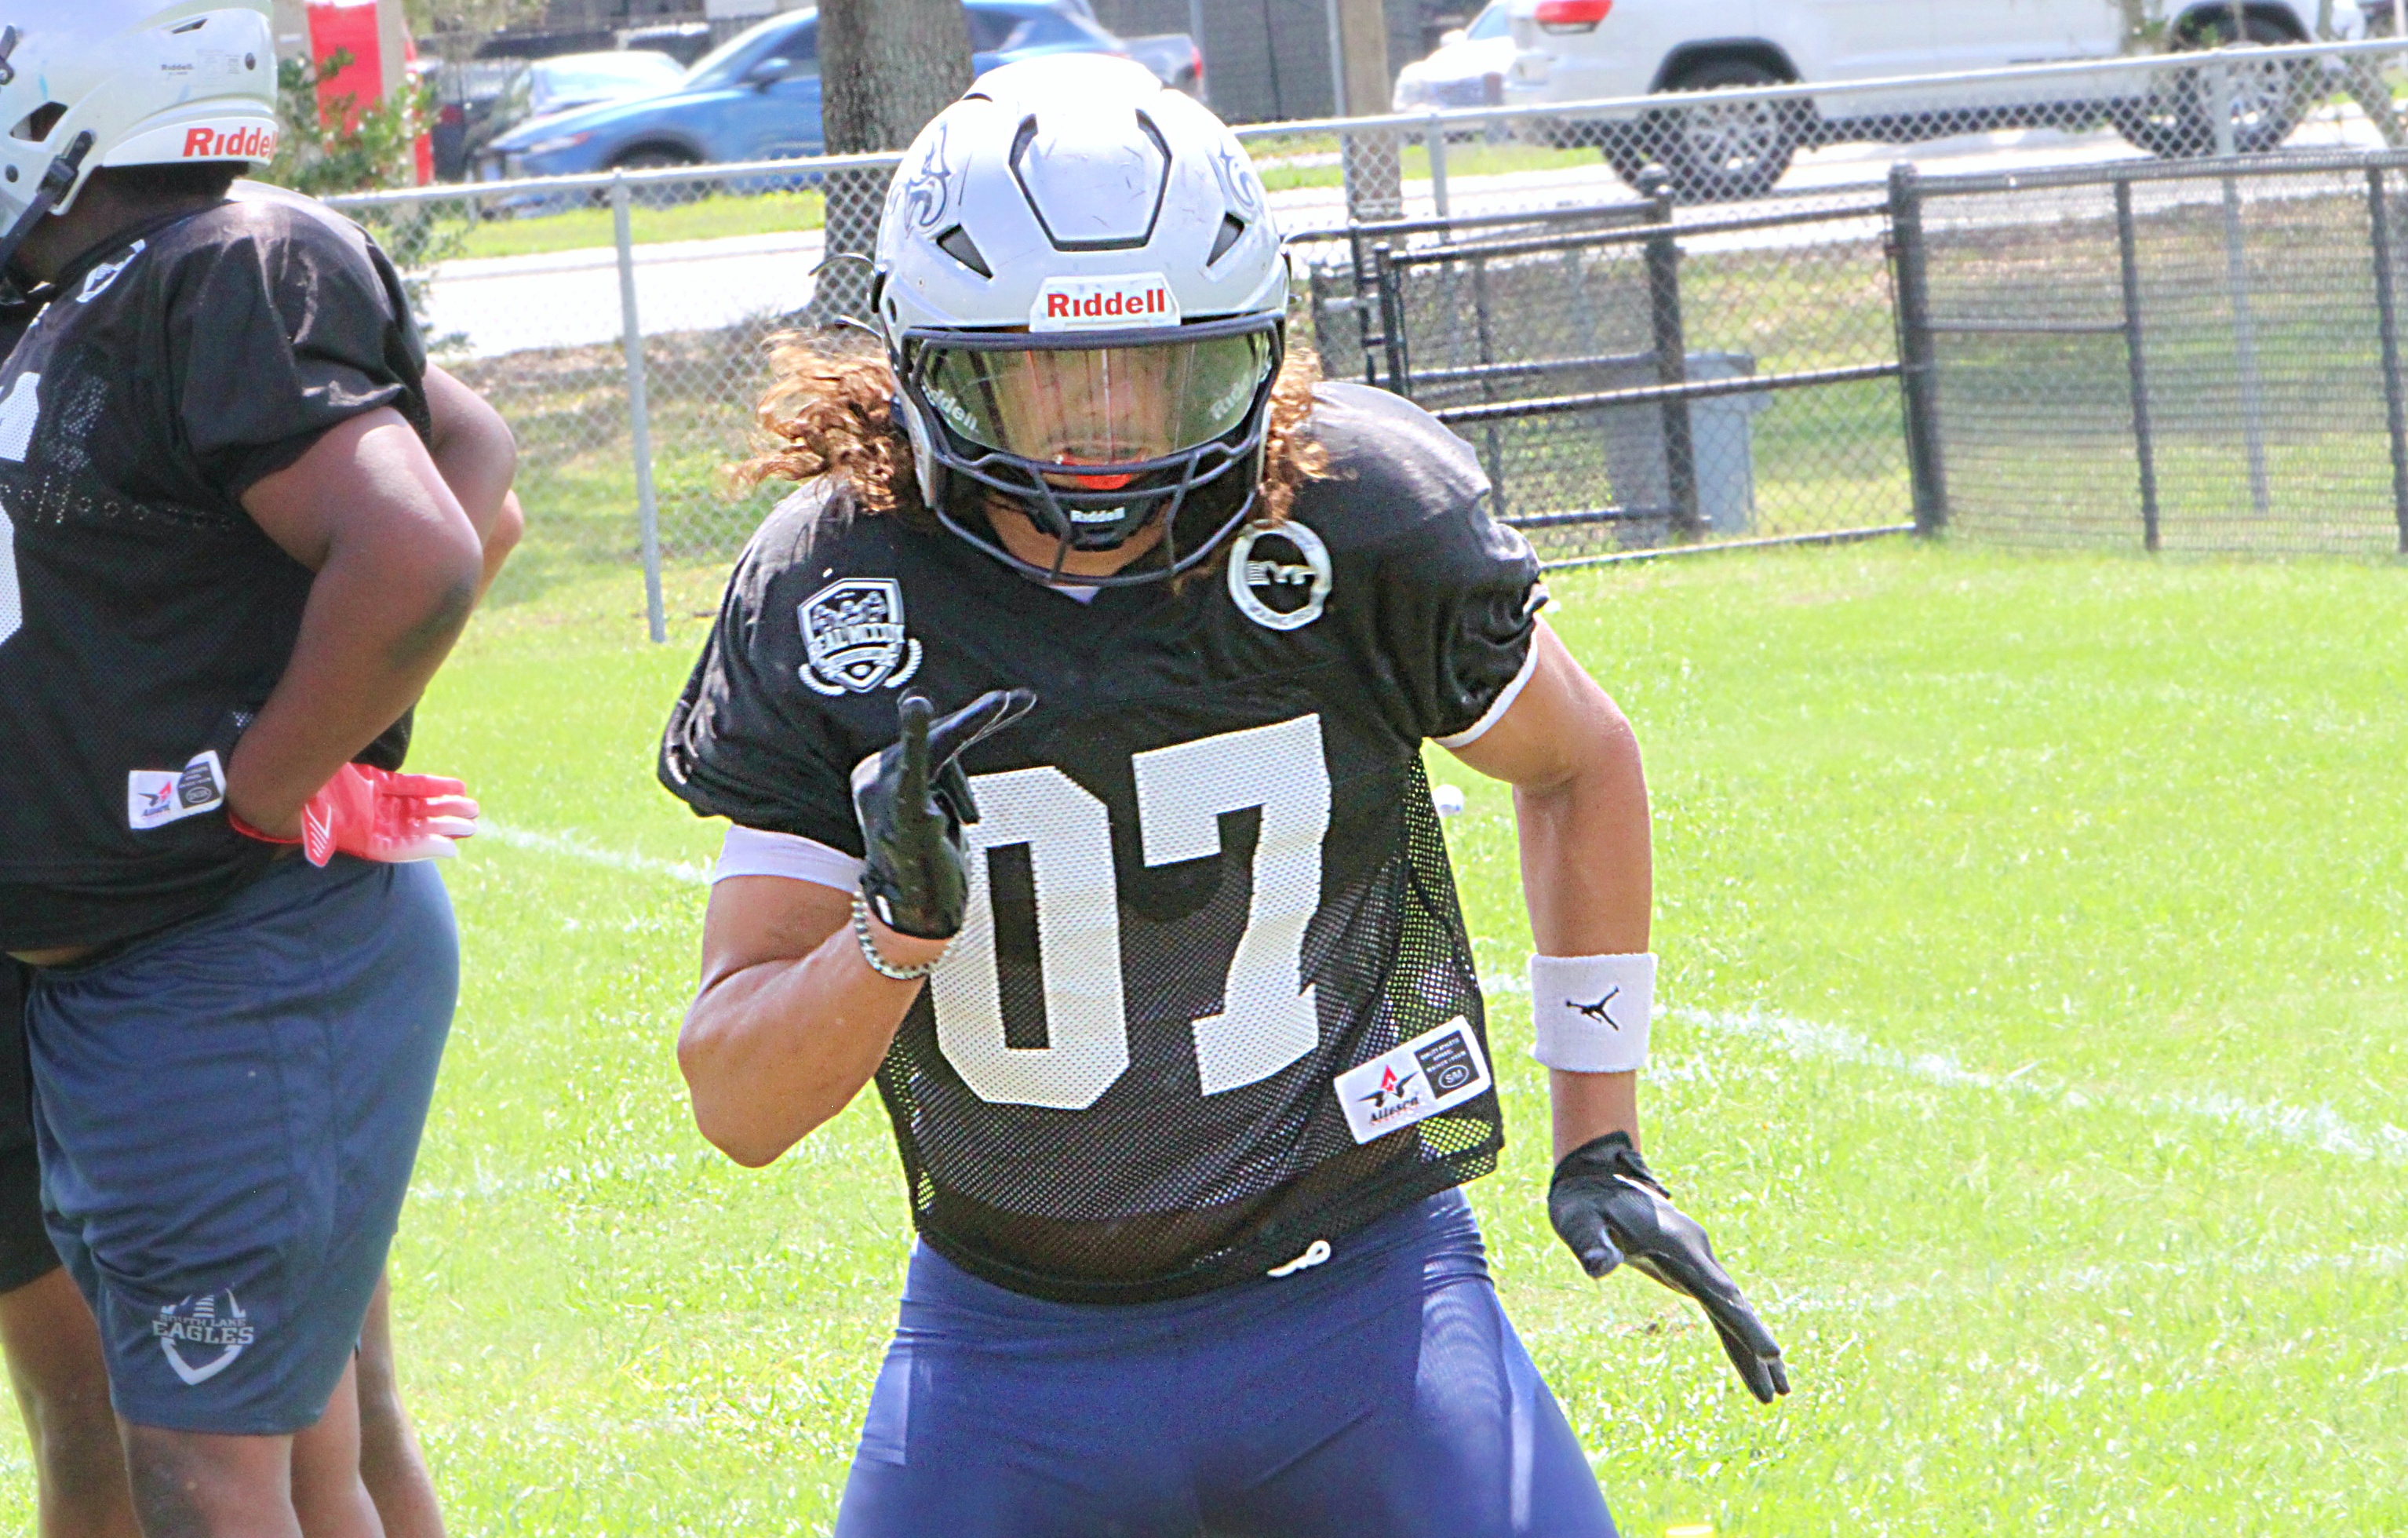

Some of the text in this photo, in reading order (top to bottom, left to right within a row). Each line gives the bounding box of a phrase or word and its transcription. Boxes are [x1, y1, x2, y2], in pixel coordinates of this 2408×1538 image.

[183, 126, 279, 162] Riddel
[1047, 288, 1165, 318] Riddell
[931, 713, 1332, 1110] 07
[151, 1320, 255, 1345] EAGLES
[159, 1314, 247, 1328] SOUTH LAKE
